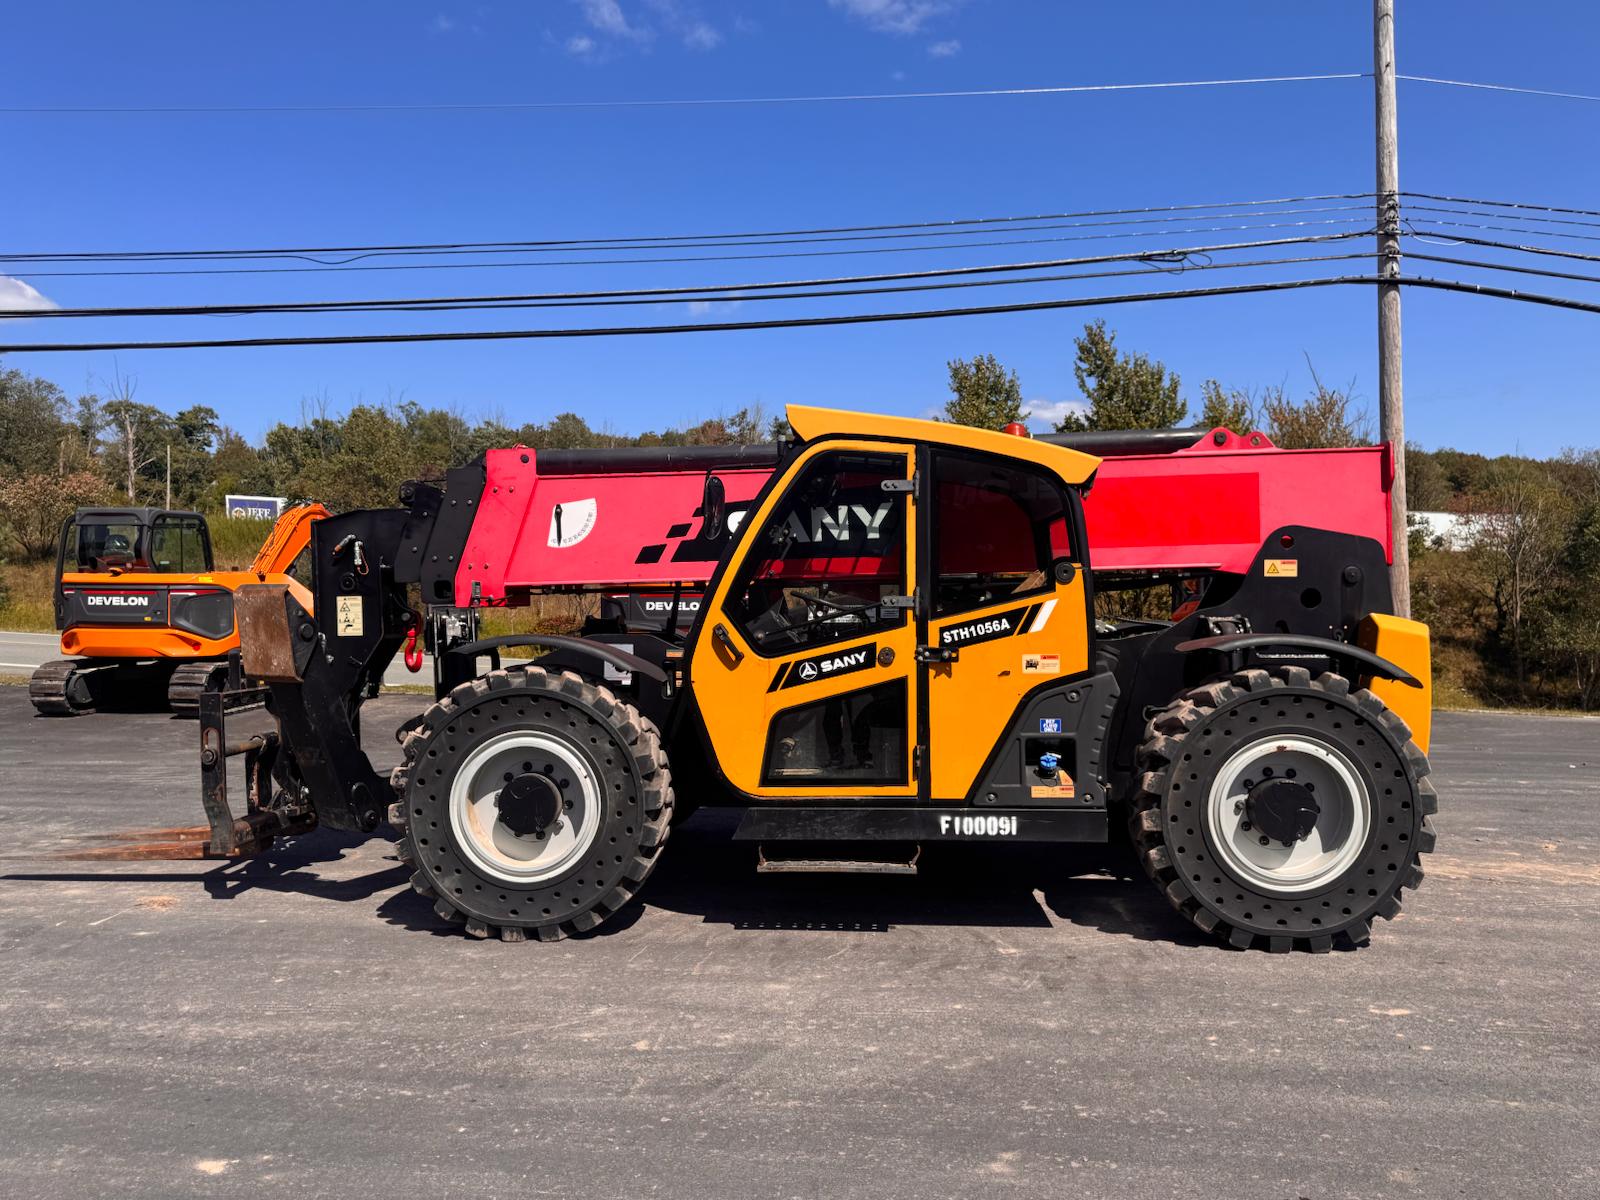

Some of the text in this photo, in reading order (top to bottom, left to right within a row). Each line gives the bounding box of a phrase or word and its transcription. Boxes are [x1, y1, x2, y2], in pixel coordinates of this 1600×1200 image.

[87, 596, 149, 606] DEVELON
[943, 618, 1011, 643] STH1056A
[820, 651, 867, 672] SANY
